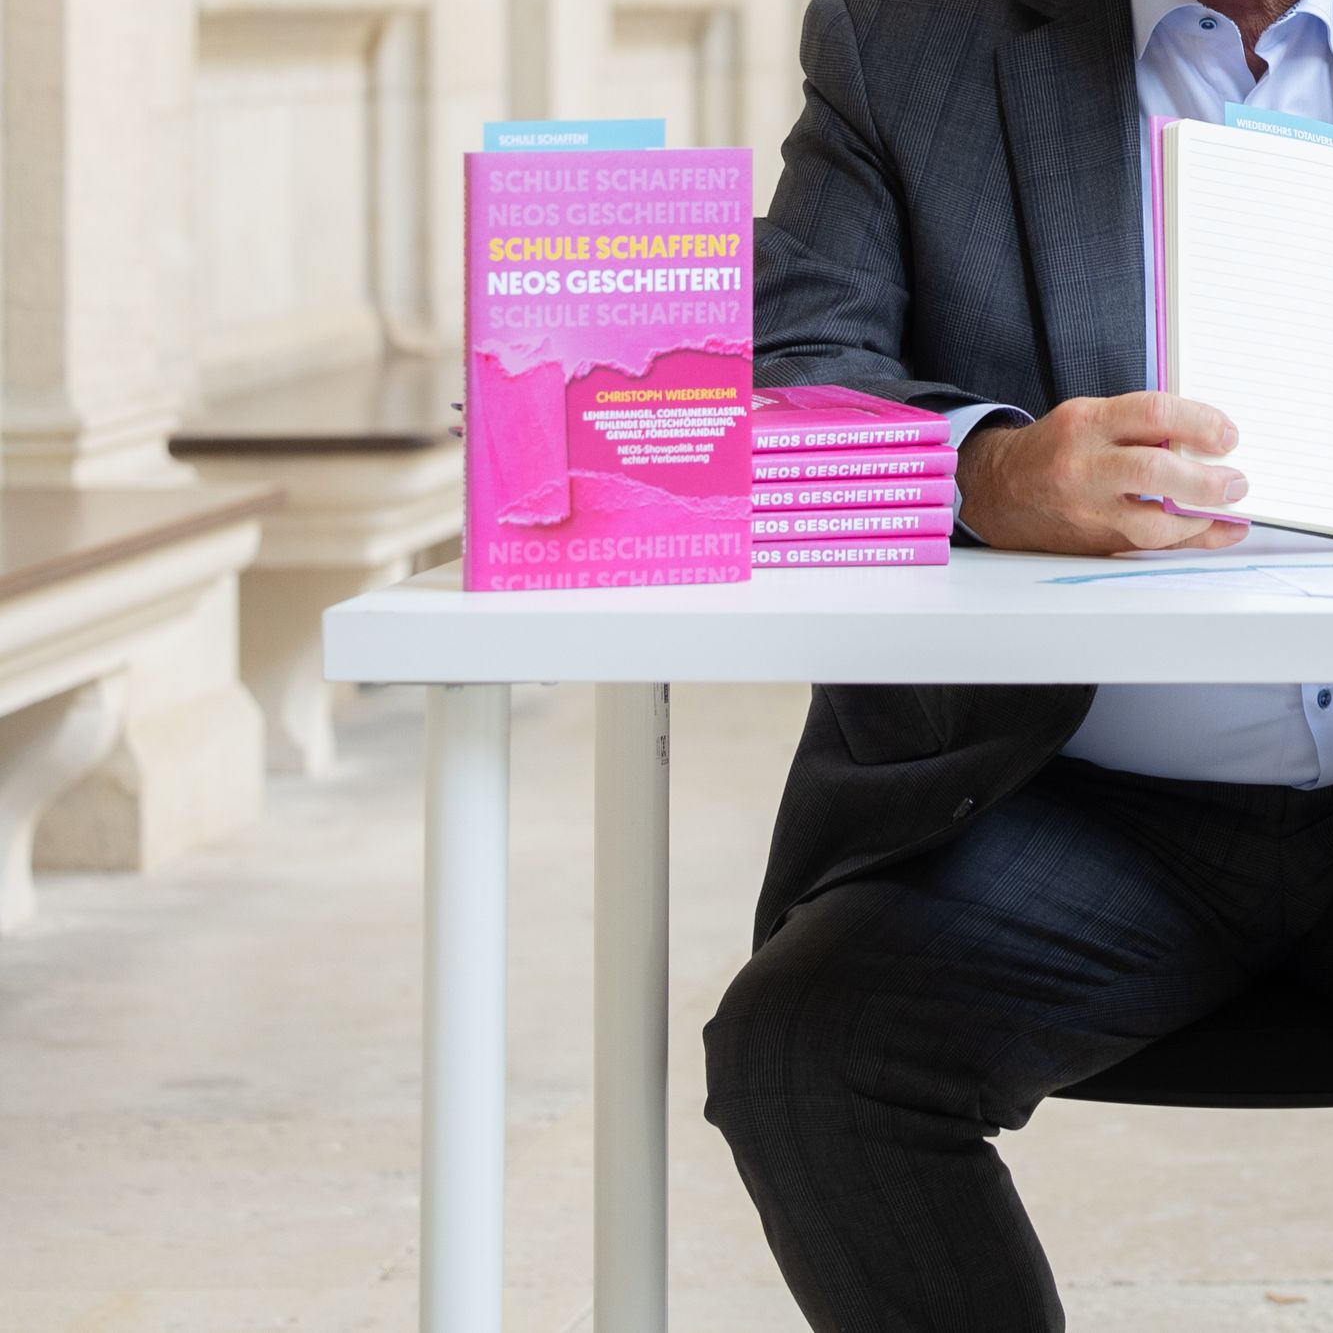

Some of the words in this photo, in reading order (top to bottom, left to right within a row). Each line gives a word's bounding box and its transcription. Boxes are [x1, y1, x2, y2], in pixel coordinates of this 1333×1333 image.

[1236, 118, 1292, 136] WIEDERKEHRS
[499, 135, 537, 145] SCHULE
[490, 170, 589, 193] SCHULE
[596, 167, 740, 191] SCHAFFEN?
[488, 204, 560, 226] NEOS
[567, 201, 740, 225] GESCHEITERT!
[489, 237, 590, 261] SCHULE
[596, 234, 740, 258] SCHAFFEN?
[488, 271, 561, 295] NEOS
[566, 268, 741, 294] GESCHEITERT!
[490, 304, 589, 328] SCHULE
[596, 301, 740, 327] SCHAFFEN?
[596, 390, 662, 403] CHRISTOPH
[665, 388, 737, 400] WIEDERKEHR
[757, 435, 800, 448] NEOS
[805, 430, 919, 446] GESCHEITERT!
[755, 466, 800, 479] NEOS
[806, 462, 925, 477] GESCHEITERT!
[799, 488, 920, 504] GESCHEITERT!
[794, 517, 919, 532] GESCHEITERT!
[489, 541, 560, 564] NEOS
[567, 533, 740, 562] GESCHEITERT!
[752, 551, 781, 563] EOS
[787, 548, 914, 562] GESCHEITERT!
